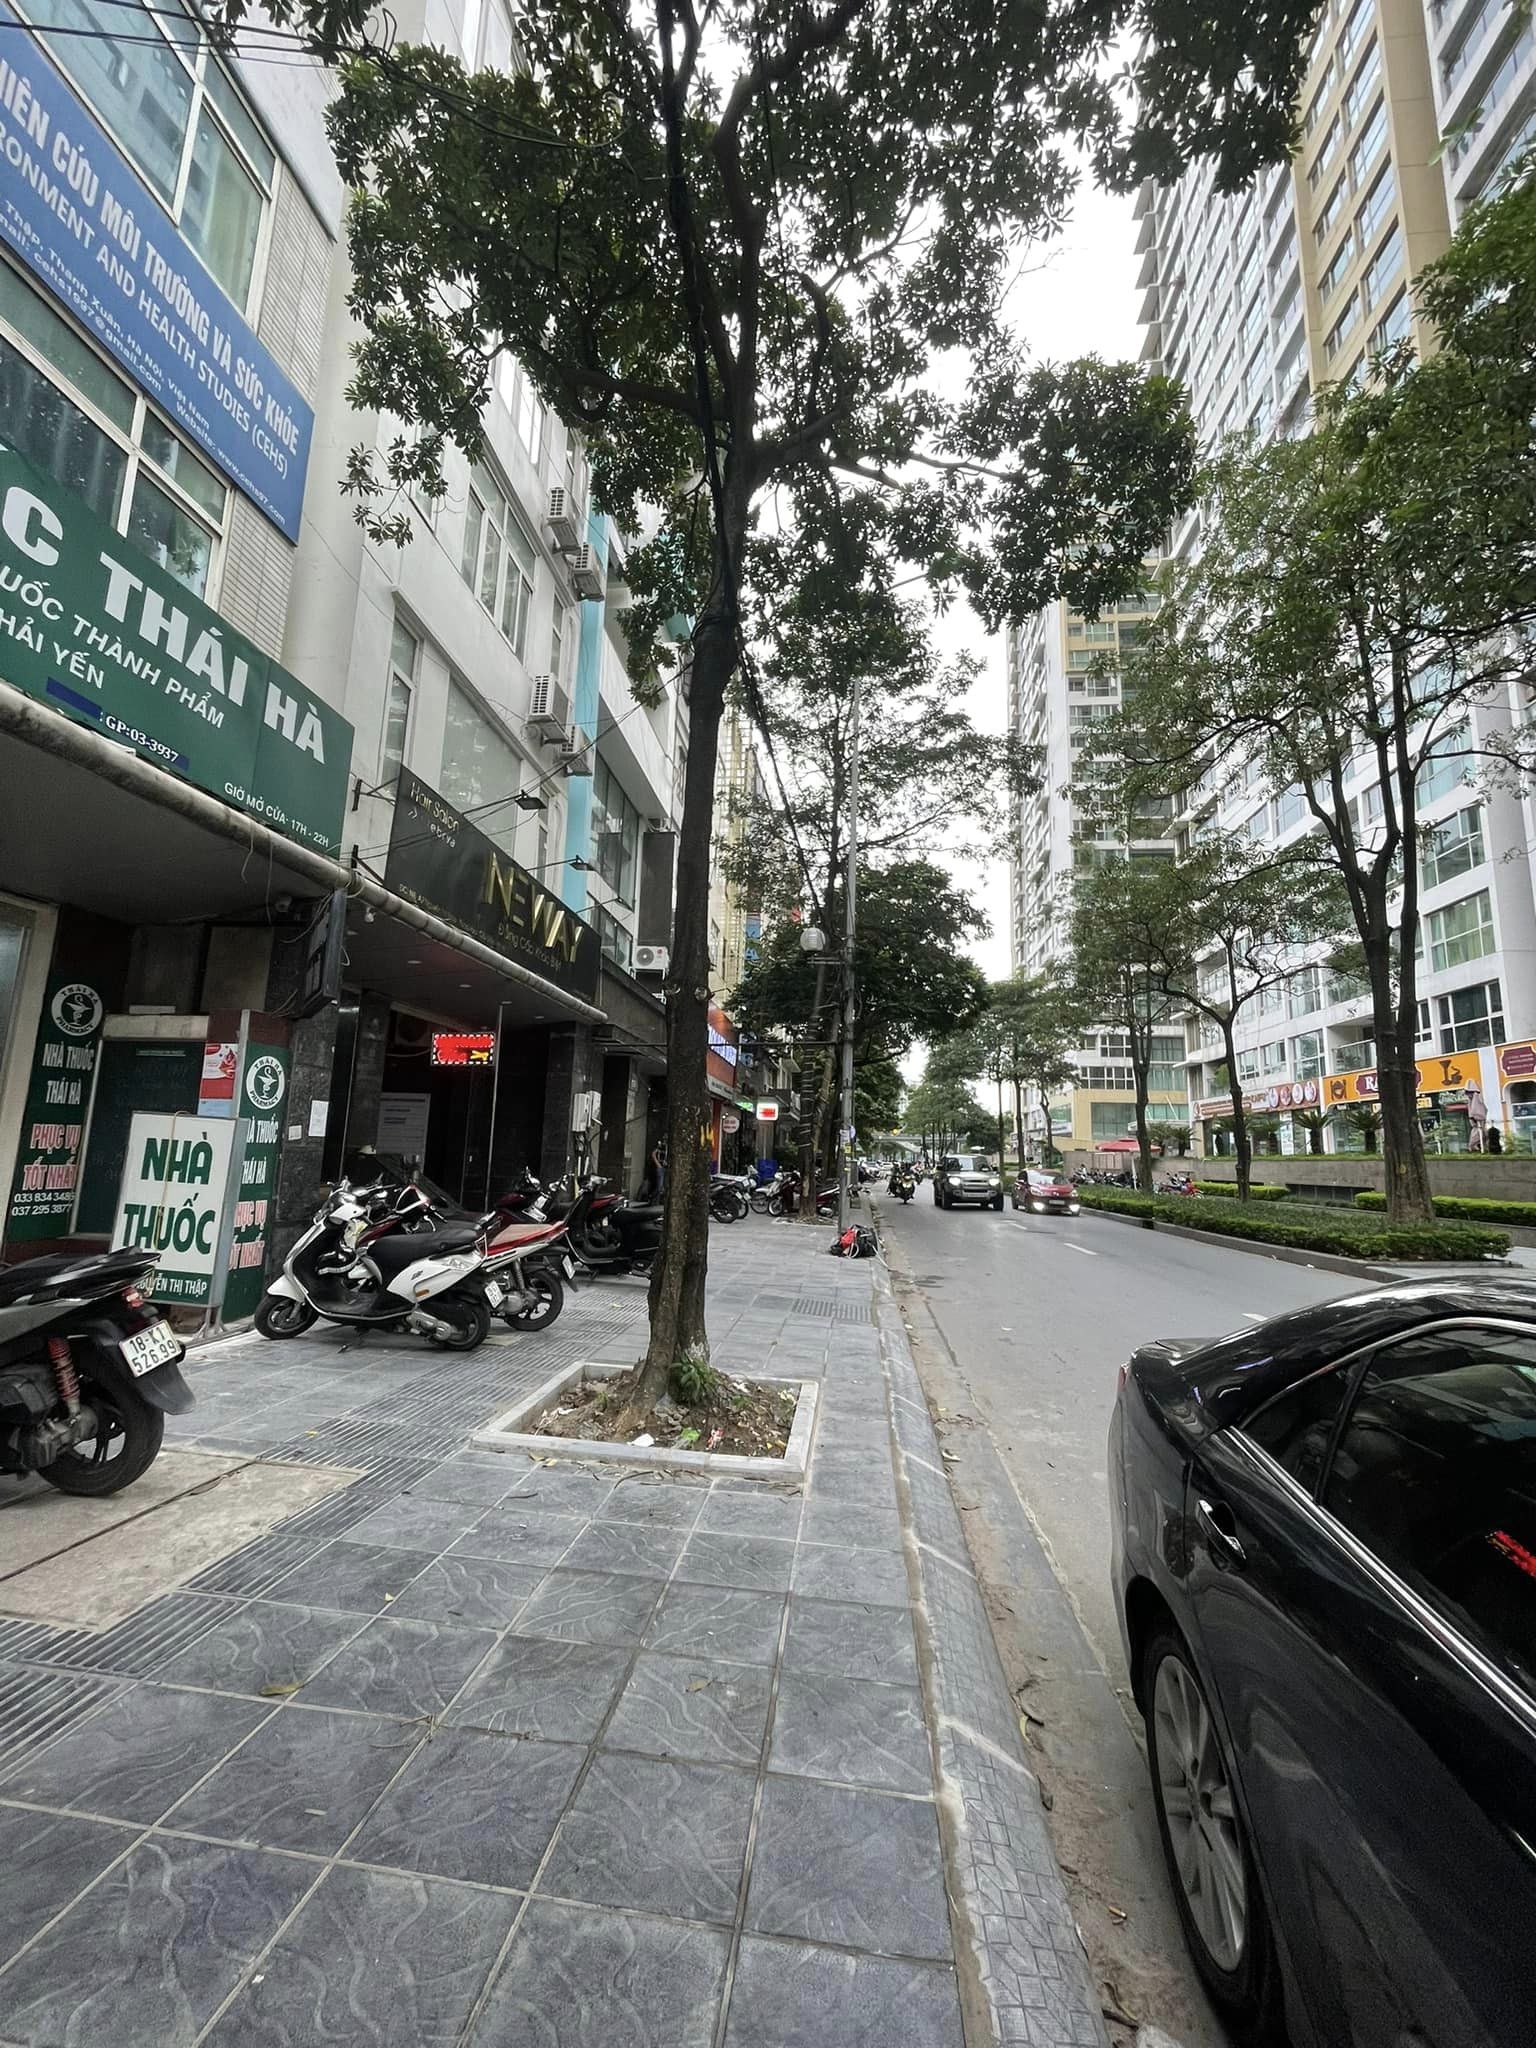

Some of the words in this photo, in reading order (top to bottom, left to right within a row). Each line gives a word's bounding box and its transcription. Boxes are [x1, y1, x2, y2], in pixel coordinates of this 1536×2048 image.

[53, 131, 99, 207] CỨU
[100, 189, 141, 262] MÔI
[144, 241, 210, 346] TRƯỜNG
[213, 326, 232, 375] VÀ
[235, 356, 263, 410] SỨC
[264, 394, 299, 456] KHỎE
[49, 248, 89, 297] Thanh
[189, 397, 210, 429] Nam
[96, 245, 135, 297] AND
[139, 289, 196, 369] HEALTH
[197, 360, 250, 432] STUDIES
[252, 424, 288, 480] (CEHS)
[176, 402, 216, 450] Website:
[0, 565, 64, 620] UỐC
[73, 614, 161, 685] THÀNH
[164, 678, 225, 728] PHẨM
[0, 608, 44, 653] HẢI
[53, 641, 104, 688] YẾN
[100, 552, 248, 707] THÁI
[264, 681, 325, 765] HÀ
[224, 782, 245, 801] GIỜ
[246, 794, 264, 811] MỞ
[291, 820, 307, 835] 17H
[313, 832, 329, 847] 22H
[483, 851, 585, 963] NEWAY
[42, 1041, 64, 1068] NHÀ
[66, 1041, 95, 1070] THUỐC
[46, 1077, 69, 1104] THÁI
[69, 1078, 81, 1104] HÀ
[30, 1123, 65, 1154] PHỤC
[65, 1124, 81, 1154] VỤ
[256, 1113, 279, 1144] THUỐC
[22, 1156, 48, 1190] TỐT
[141, 1132, 213, 1185] NHÀ
[256, 1156, 267, 1184] HÀ
[11, 1206, 31, 1217] 037
[31, 1204, 50, 1215] 295
[14, 1193, 33, 1203] 033
[34, 1192, 52, 1202] 834
[123, 1193, 216, 1255] THUỐC
[255, 1200, 268, 1231] VỤ
[169, 1278, 184, 1296] THỊ
[184, 1278, 208, 1298] THẬP
[130, 1326, 165, 1354] 18-K1
[132, 1339, 178, 1373] 526.99
